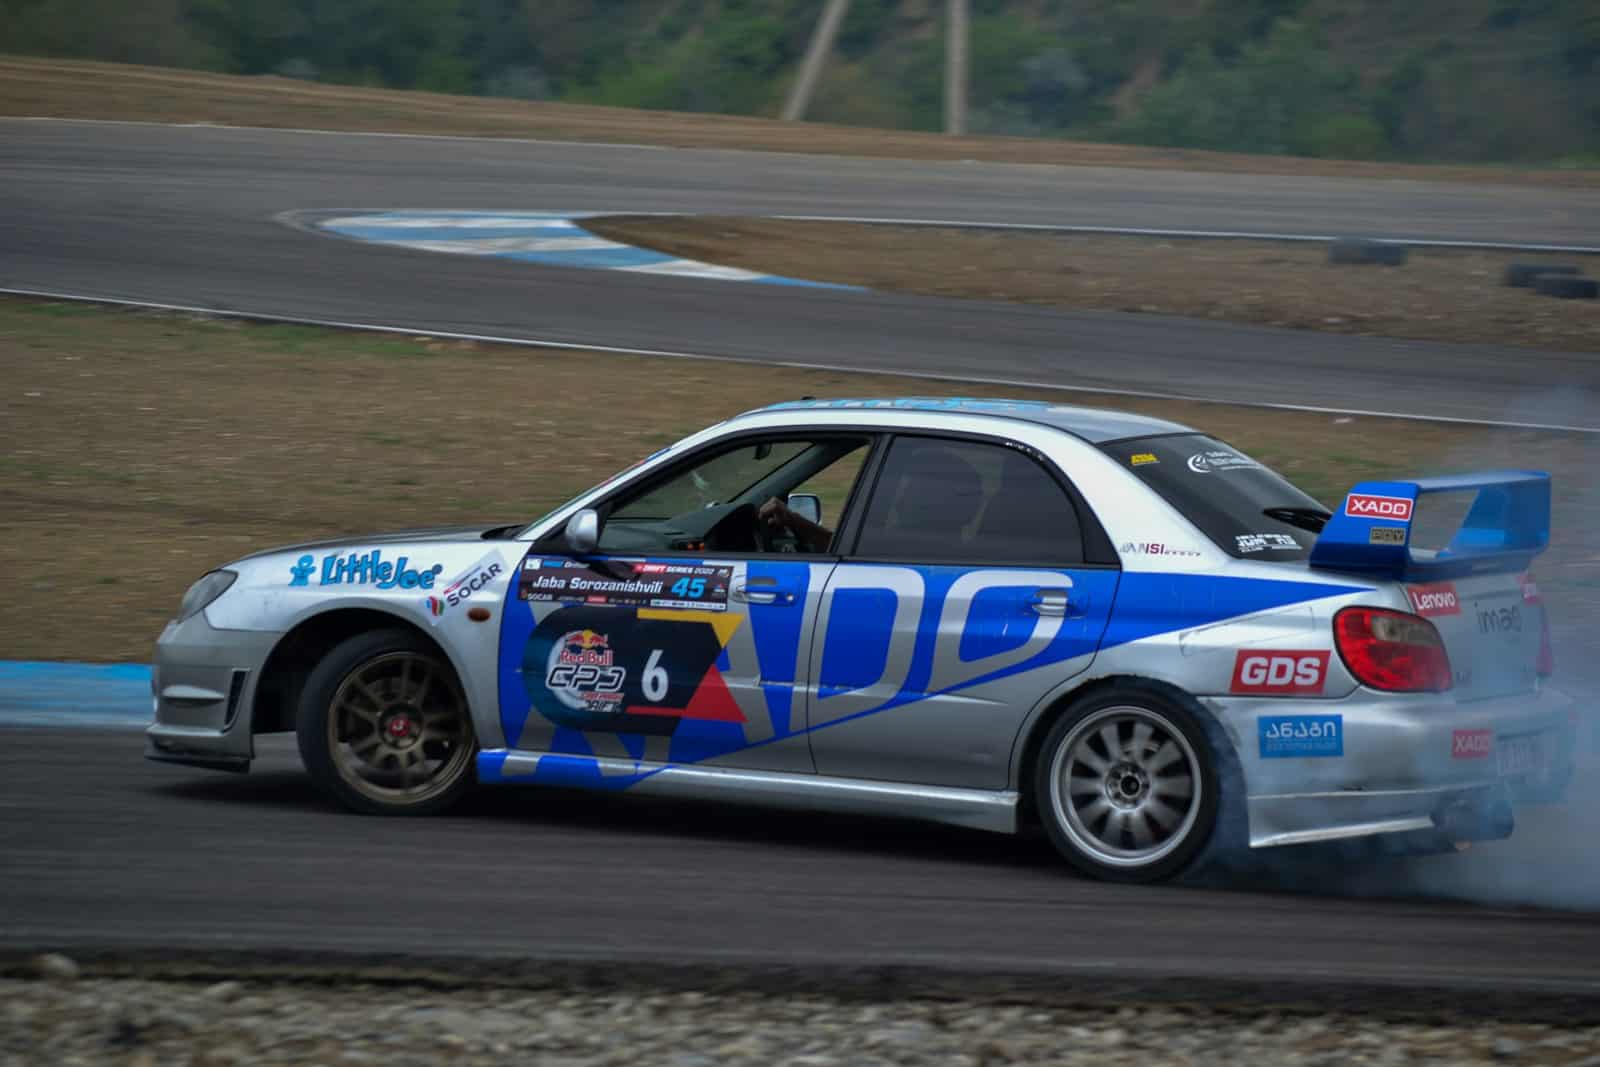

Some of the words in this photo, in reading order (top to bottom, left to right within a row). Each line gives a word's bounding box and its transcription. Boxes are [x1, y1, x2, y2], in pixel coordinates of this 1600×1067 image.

[1351, 498, 1407, 516] XADO
[447, 562, 502, 607] SOCAR
[532, 575, 566, 590] Jaba
[570, 576, 664, 594] Sorozanishvili
[671, 577, 707, 598] 45
[1412, 591, 1456, 610] Lenovo
[560, 649, 585, 665] Red
[588, 649, 614, 666] Bull
[641, 649, 669, 702] 6
[1241, 656, 1321, 686] GDS
[1265, 720, 1337, 738] ანაგი
